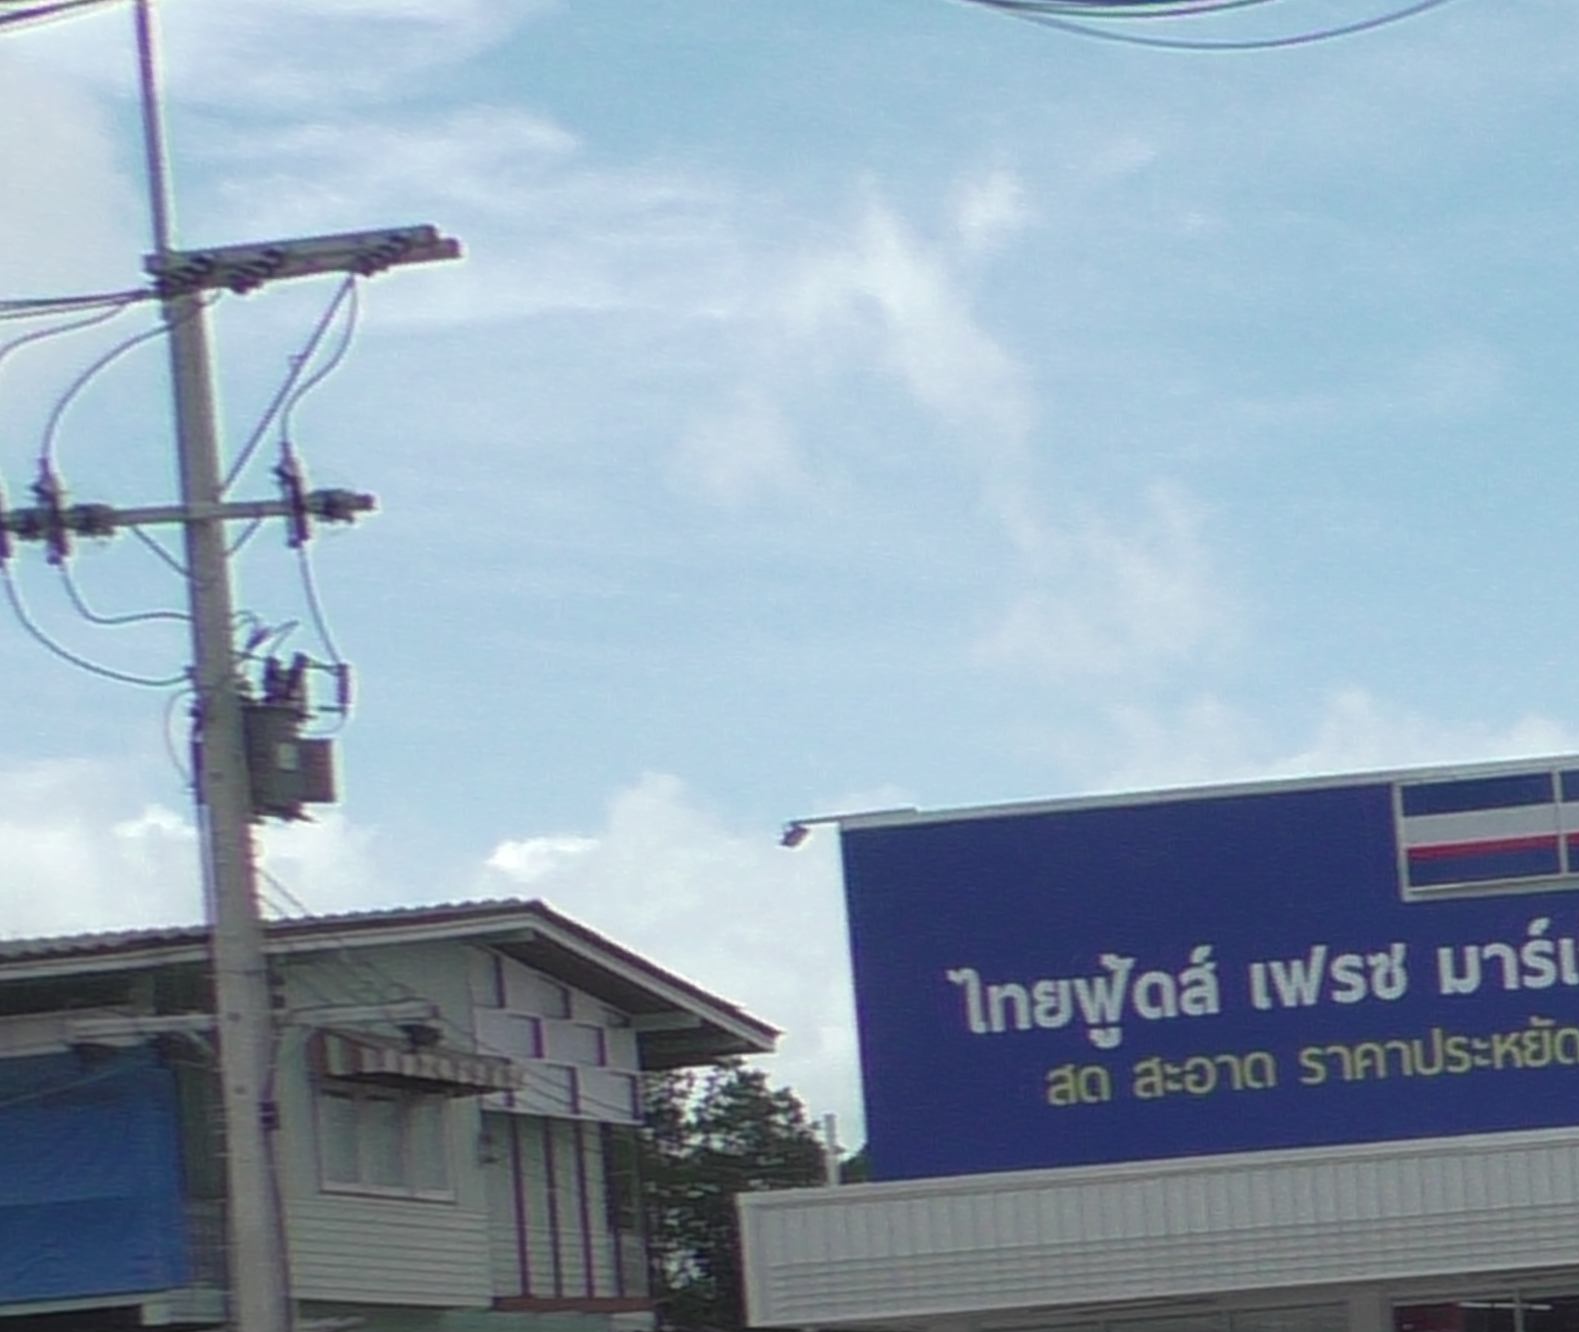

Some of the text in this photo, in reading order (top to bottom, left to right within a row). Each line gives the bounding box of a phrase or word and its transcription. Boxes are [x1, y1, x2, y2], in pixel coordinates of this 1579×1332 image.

[945, 945, 1221, 1049] ไทยฟู้ดส์
[1046, 1063, 1112, 1106] สด
[1132, 1050, 1278, 1099] สะอาด
